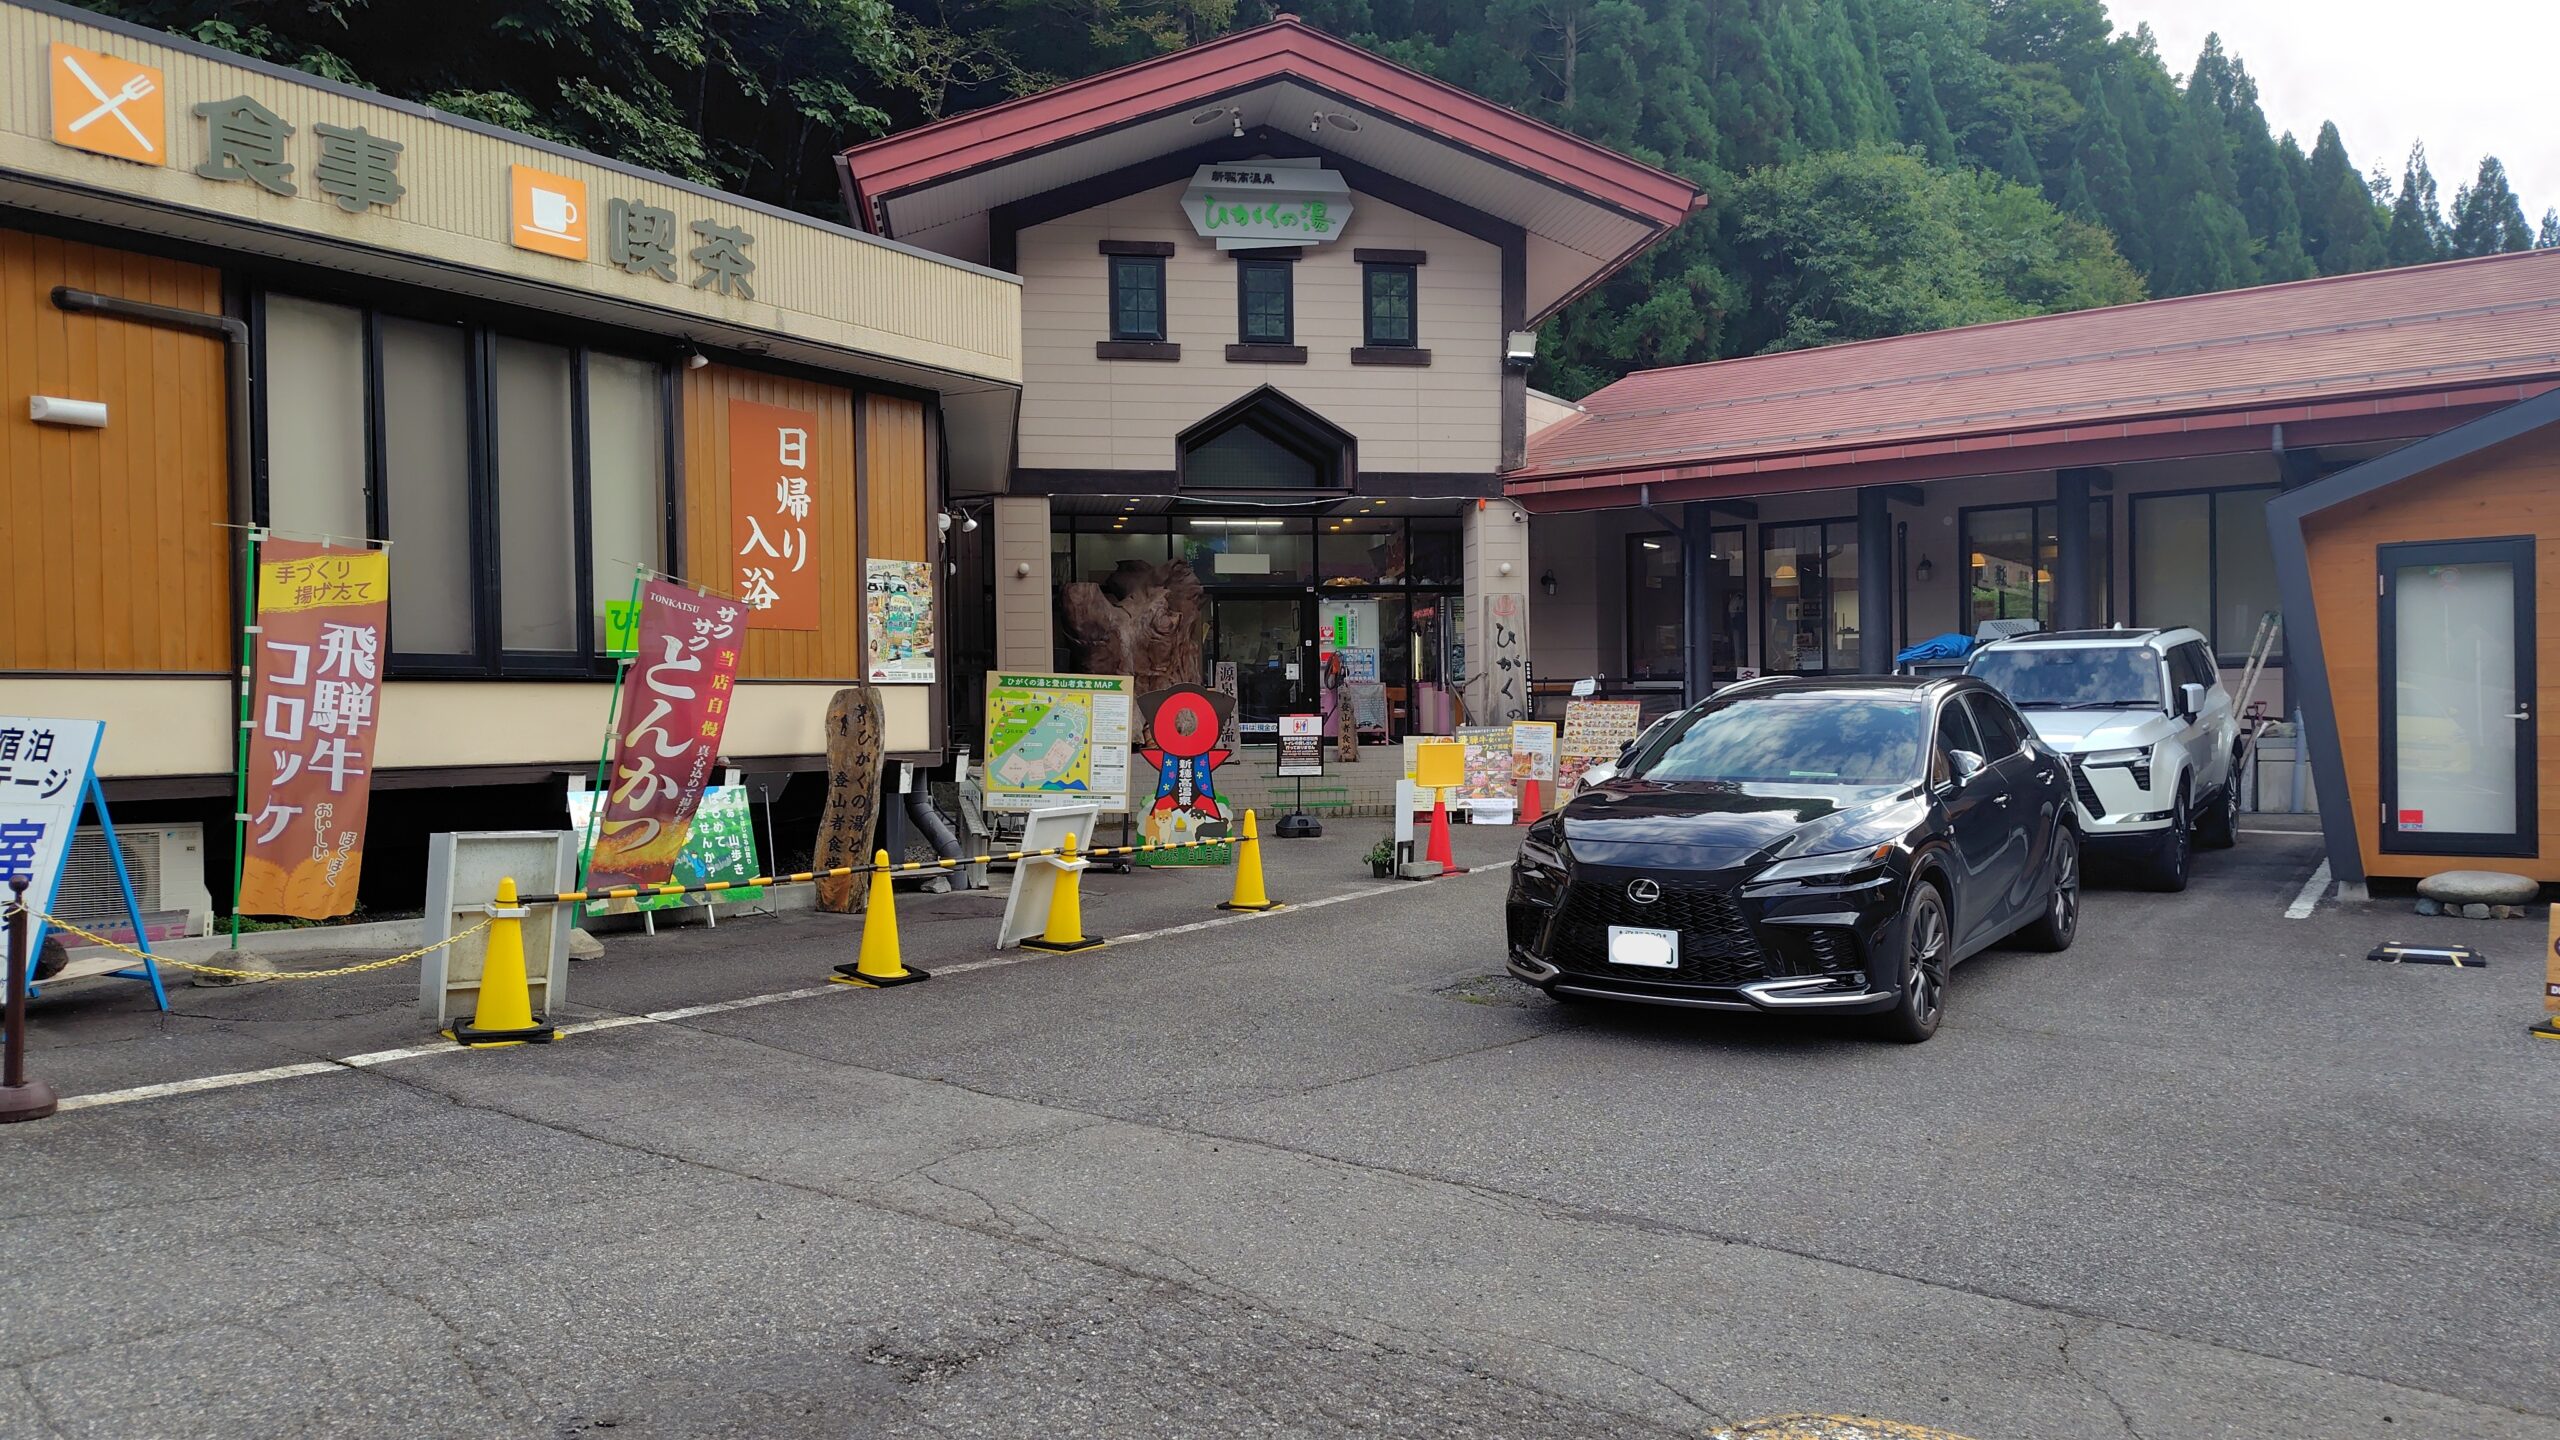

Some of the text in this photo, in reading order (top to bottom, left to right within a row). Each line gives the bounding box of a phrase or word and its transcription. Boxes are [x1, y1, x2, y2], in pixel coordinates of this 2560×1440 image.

[194, 95, 406, 213] 食事
[609, 197, 757, 300] 喫茶
[776, 426, 812, 573] 日帰り
[275, 560, 351, 585] 手づくり
[293, 581, 372, 606] 揚げたて
[739, 515, 781, 610] 入浴
[650, 591, 700, 613] TONKATSU
[308, 622, 377, 792] 飛騨牛
[702, 650, 736, 738] 当店自慢
[1007, 678, 1114, 689] ひがくの湯と登山者食堂 MAP
[255, 641, 311, 845] コロッケ
[601, 635, 702, 855] とんかつ
[1178, 759, 1193, 806] 新穂高温泉
[0, 818, 47, 882] 室
[312, 802, 334, 861] おいしい
[325, 831, 357, 888] ほくほく
